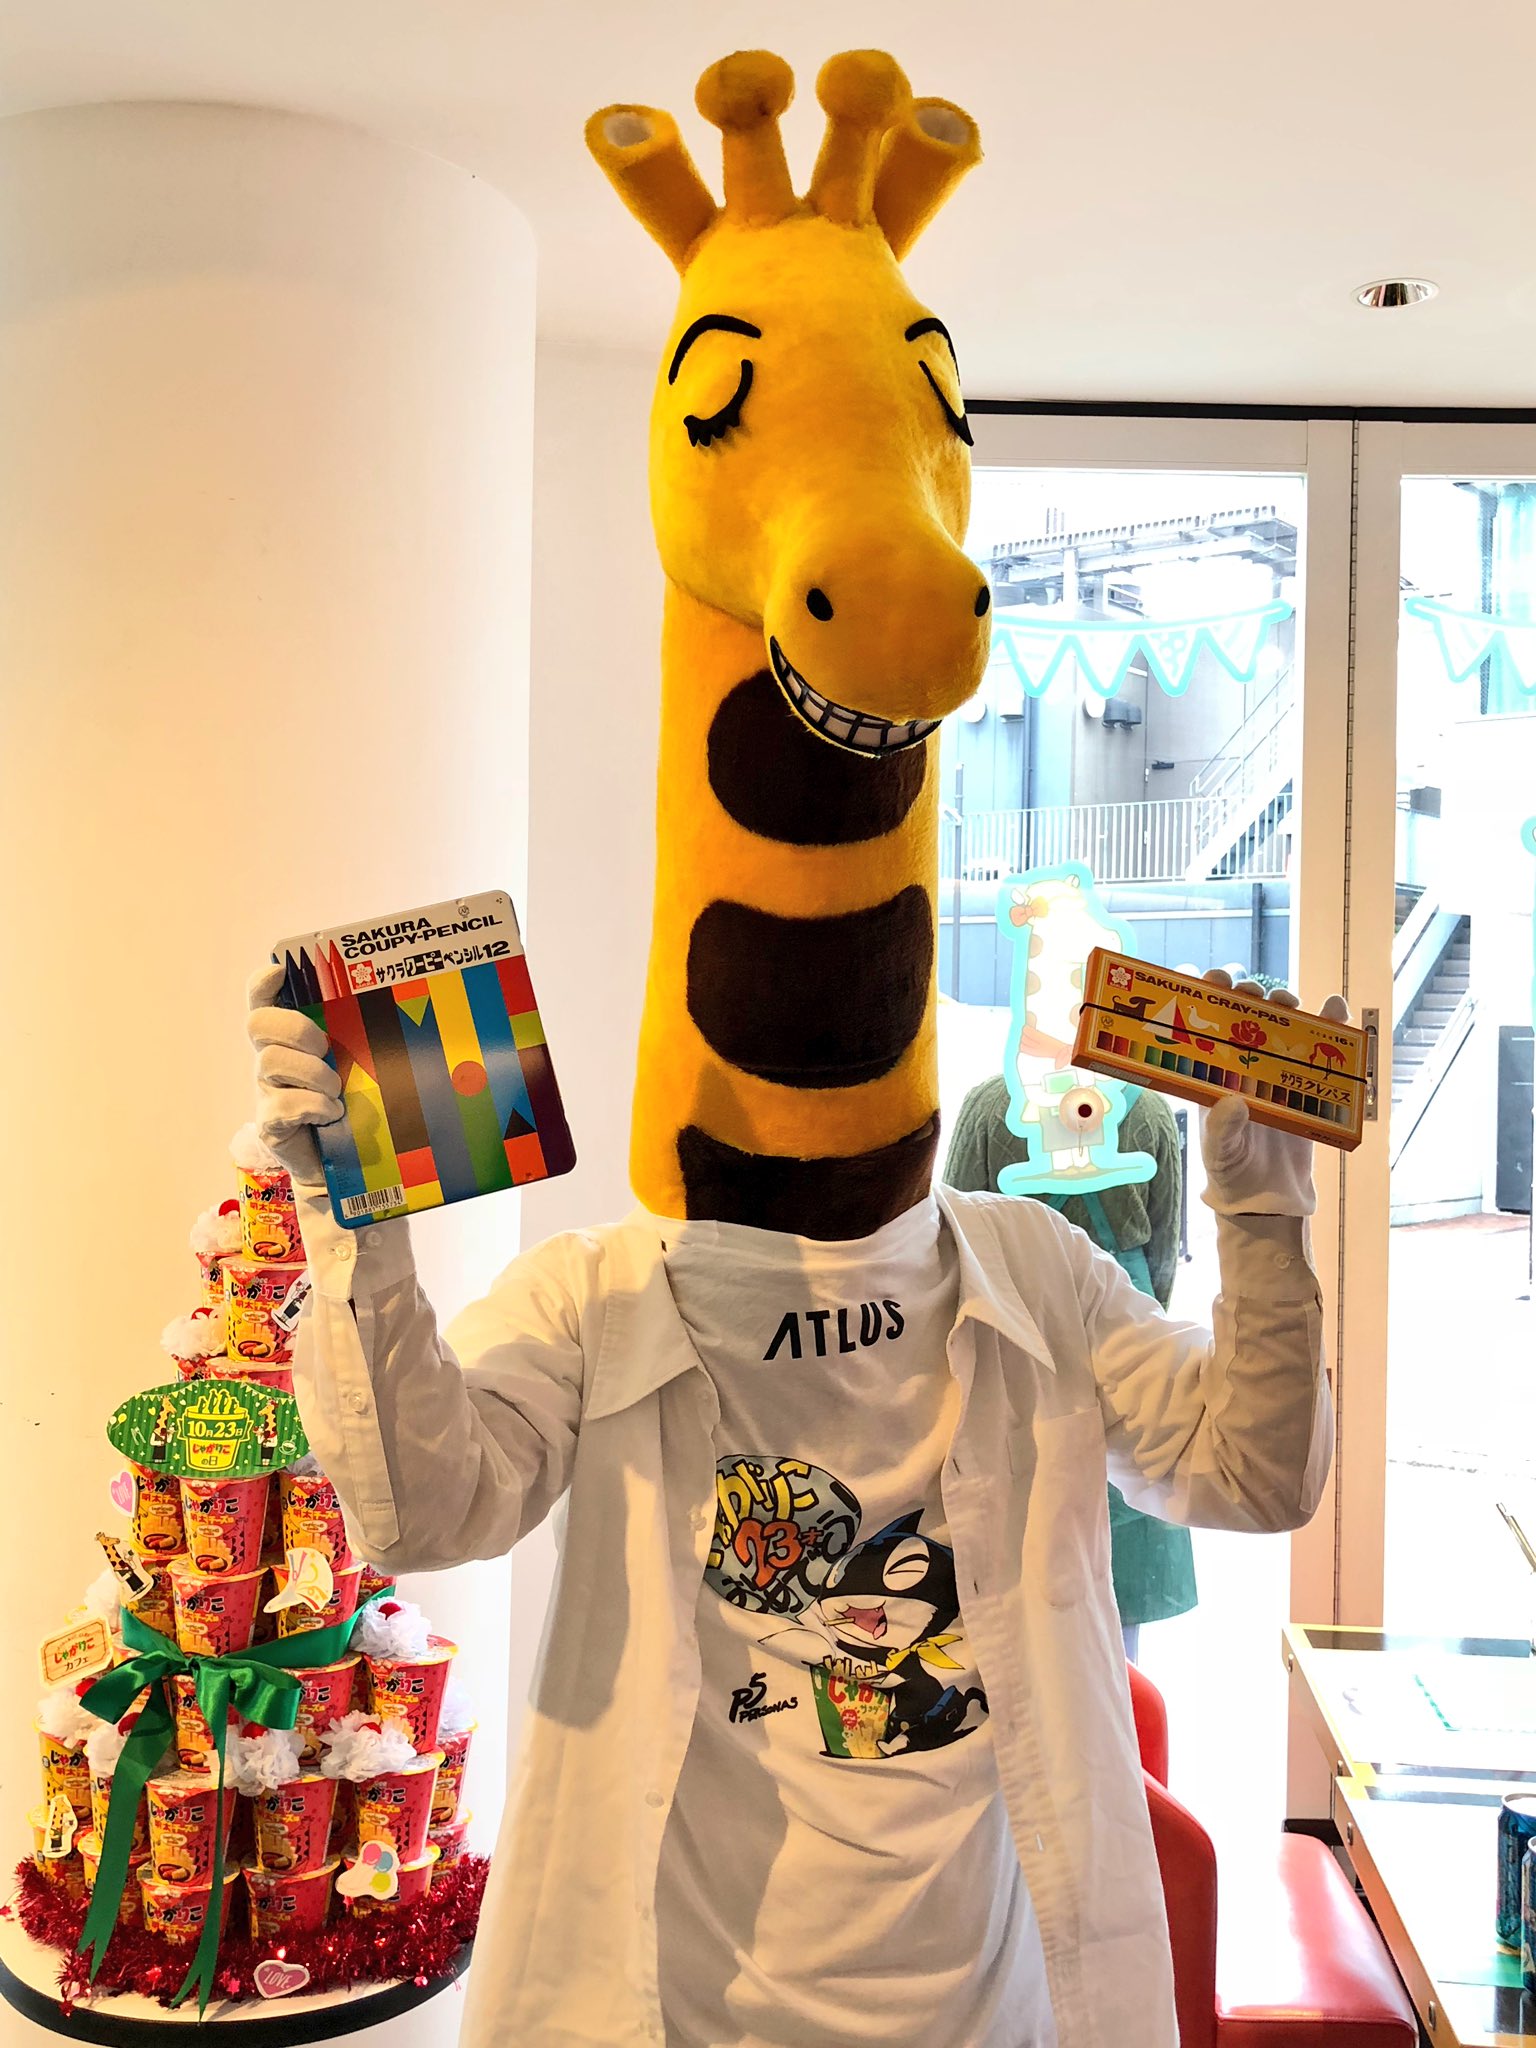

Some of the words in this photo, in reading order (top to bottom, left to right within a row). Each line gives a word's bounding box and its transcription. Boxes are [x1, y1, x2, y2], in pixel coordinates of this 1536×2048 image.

[340, 917, 431, 947] SAKURA
[344, 914, 503, 959] COUPY-PENCIL
[1135, 971, 1203, 1000] SAKURA
[1206, 994, 1291, 1027] CRAY-PAS
[231, 1282, 286, 1300] じゃがりこ
[763, 1300, 905, 1360] ATLUS
[187, 1421, 243, 1438] 10月23日
[185, 1494, 238, 1513] じゃがりこ
[371, 1672, 425, 1693] じゃがりこ
[151, 1799, 204, 1823] じゃがりこ
[147, 1901, 203, 1923] じゃがりこ
[263, 1970, 293, 1989] LOVE
